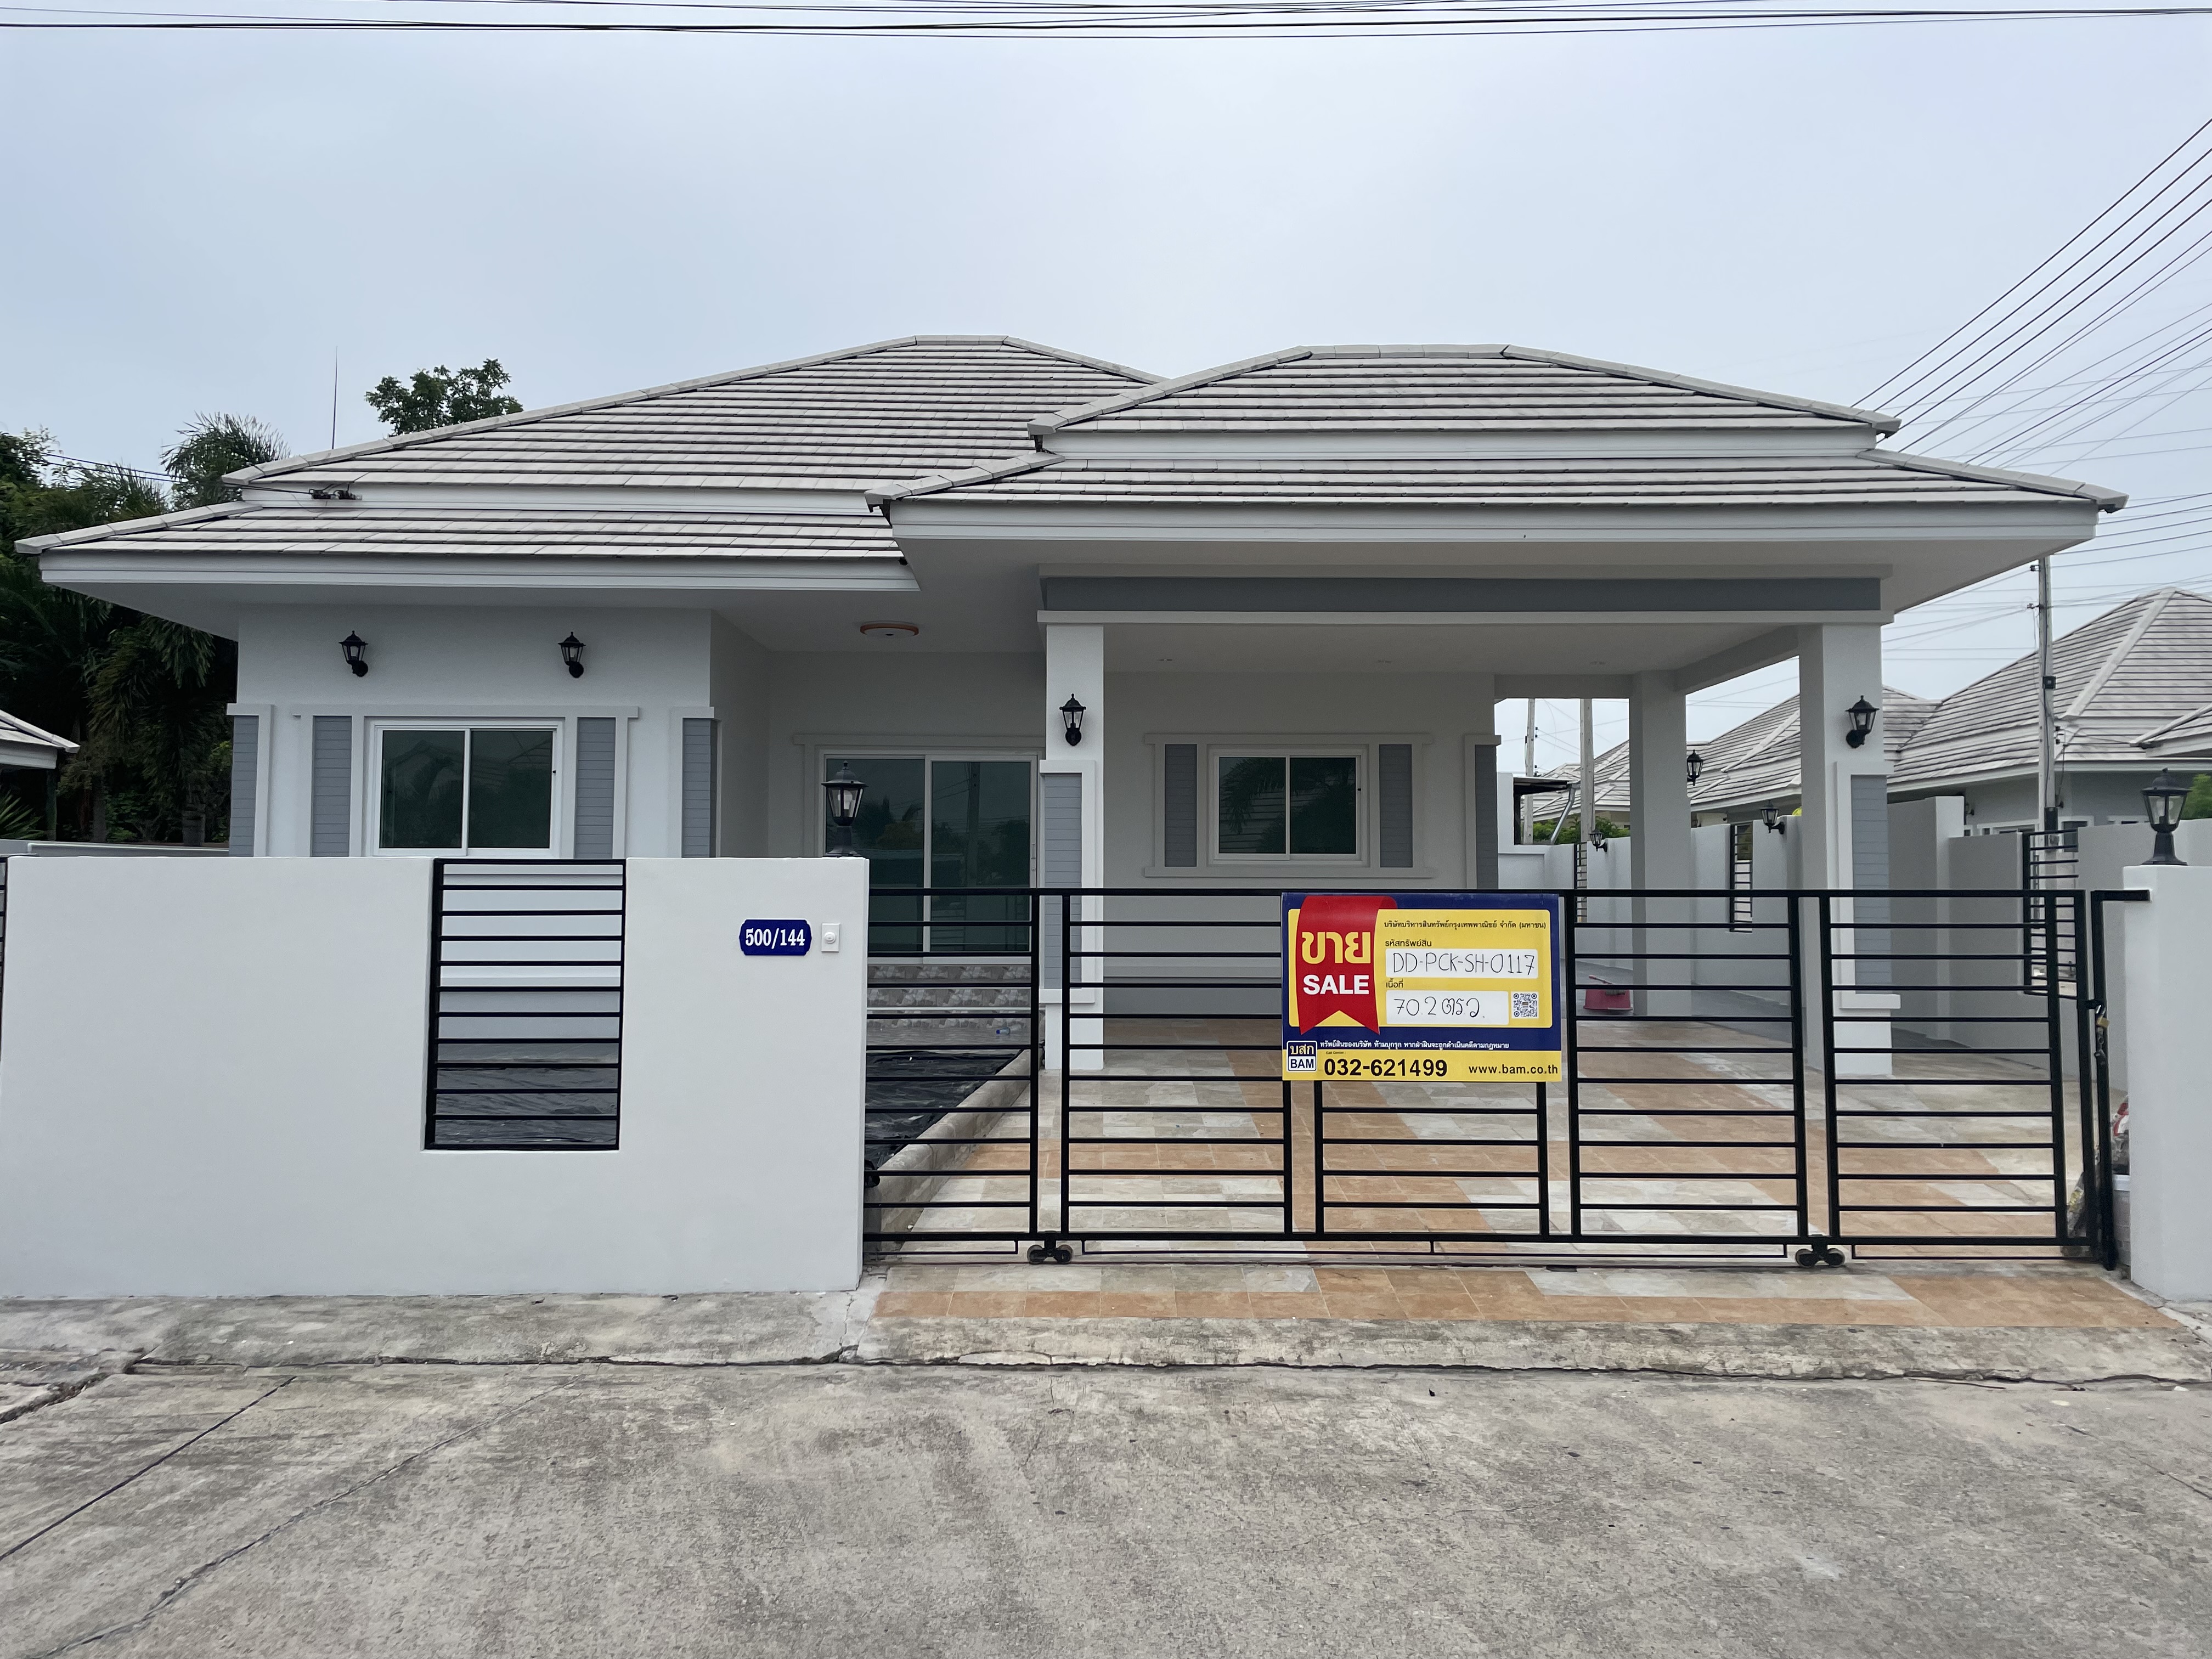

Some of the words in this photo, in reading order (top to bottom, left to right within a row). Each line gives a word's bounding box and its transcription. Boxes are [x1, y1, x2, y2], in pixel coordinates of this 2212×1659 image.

[1500, 920, 1516, 928] จำกัด
[746, 928, 805, 949] 500/144
[1385, 939, 1432, 947] รหัสทรัพย์สิน
[1302, 932, 1370, 964] ขาย
[1303, 974, 1369, 995] SALE
[1386, 978, 1403, 988] เนื้อที่
[1290, 1044, 1314, 1054] บสก
[1320, 1039, 1372, 1047] ทรัพย์สินของบริษัท
[1374, 1040, 1402, 1049] ห้ามบุกรุก
[1291, 1059, 1314, 1069] BAM
[1324, 1058, 1448, 1077] 032-621499
[1468, 1064, 1558, 1074] www.bam.co.th
